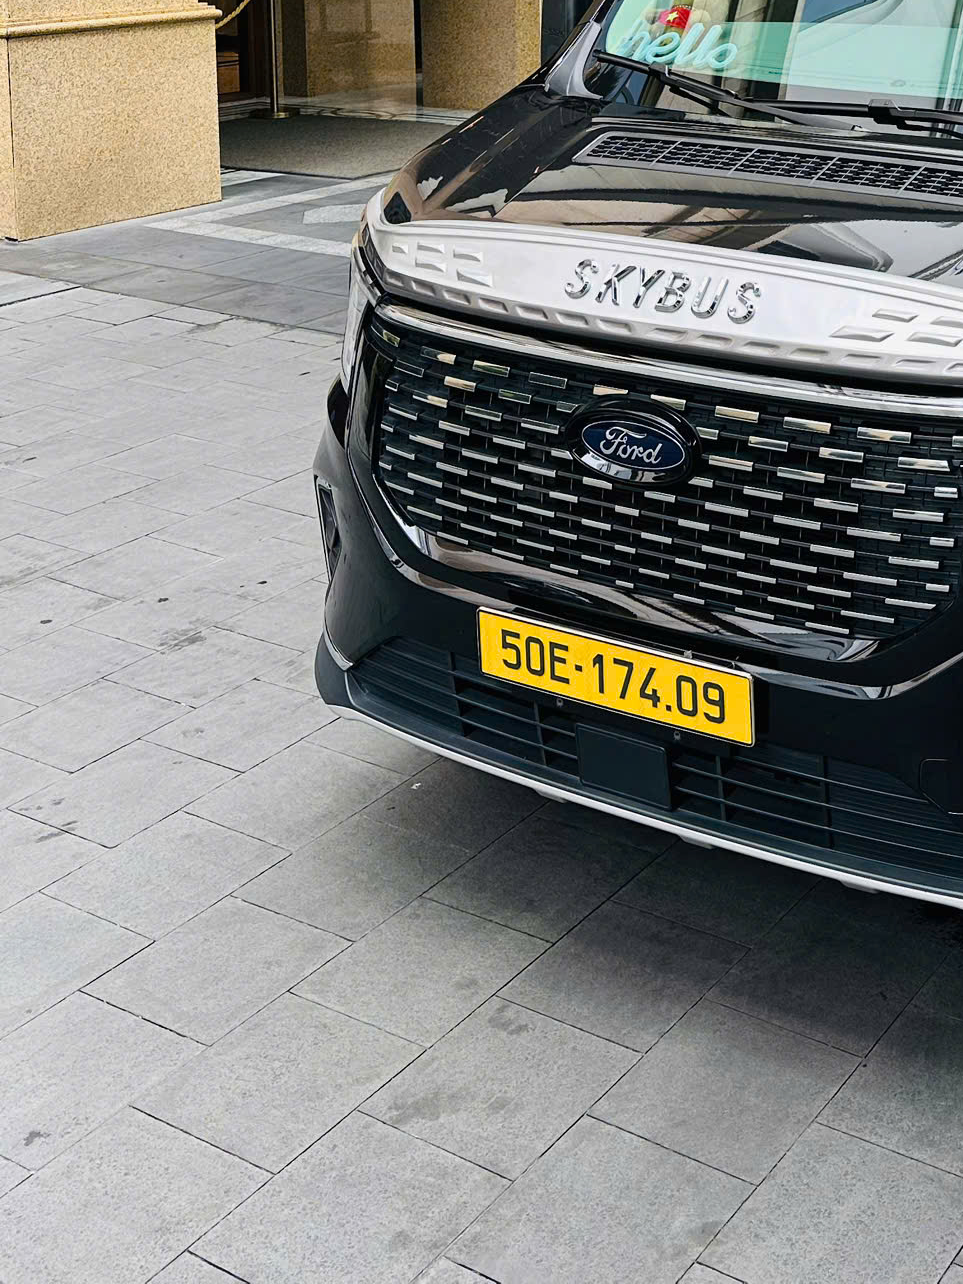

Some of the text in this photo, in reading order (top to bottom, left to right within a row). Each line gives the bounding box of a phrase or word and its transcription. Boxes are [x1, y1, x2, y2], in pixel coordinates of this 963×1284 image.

[615, 20, 738, 69] hello
[565, 259, 764, 324] SKYBUS
[600, 426, 663, 464] Ford
[501, 628, 726, 724] 50E-174.09
